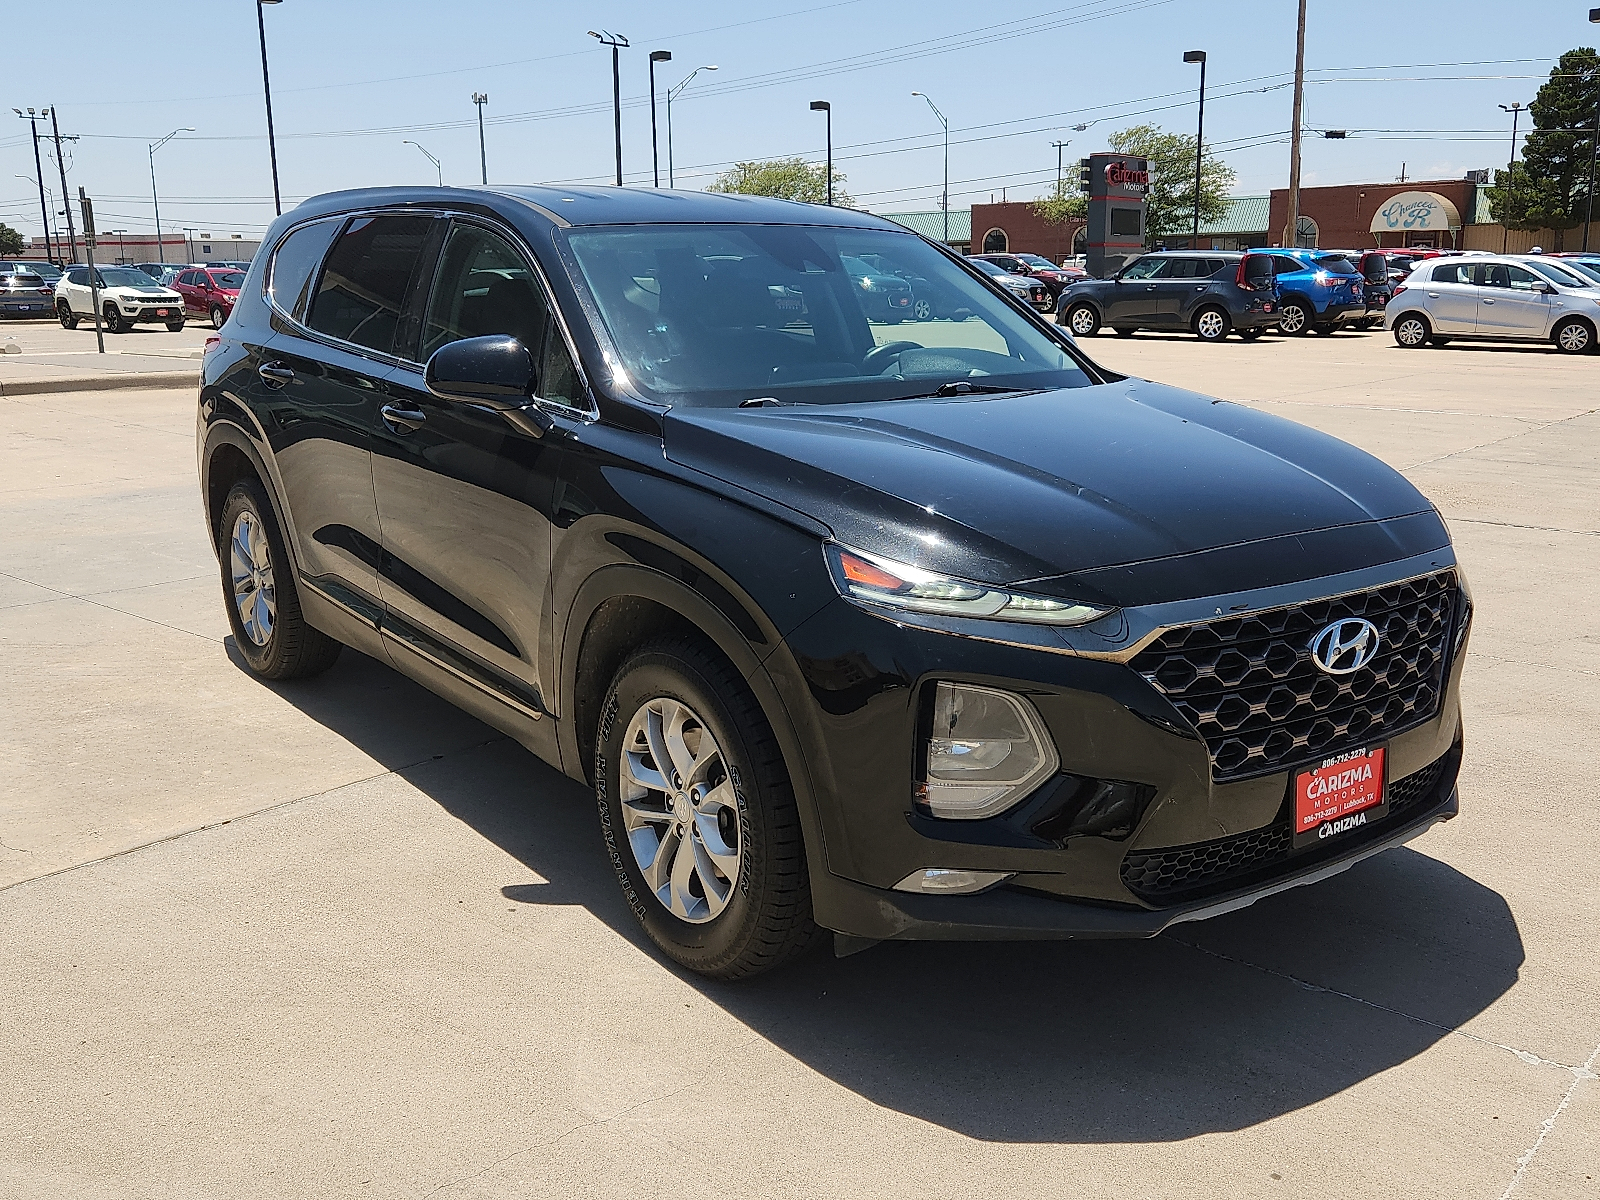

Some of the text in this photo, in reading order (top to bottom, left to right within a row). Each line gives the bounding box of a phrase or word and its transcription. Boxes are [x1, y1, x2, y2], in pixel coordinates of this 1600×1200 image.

[1123, 182, 1145, 192] Motors
[1382, 201, 1438, 228] Chances
[1403, 208, 1432, 228] R
[1322, 747, 1367, 769] 806-712-2279
[1306, 763, 1373, 799] CARIZMA
[1314, 785, 1365, 809] MOTORS
[1367, 792, 1375, 801] TX
[731, 766, 751, 899] SAILUN
[1318, 812, 1368, 839] CARIZMA
